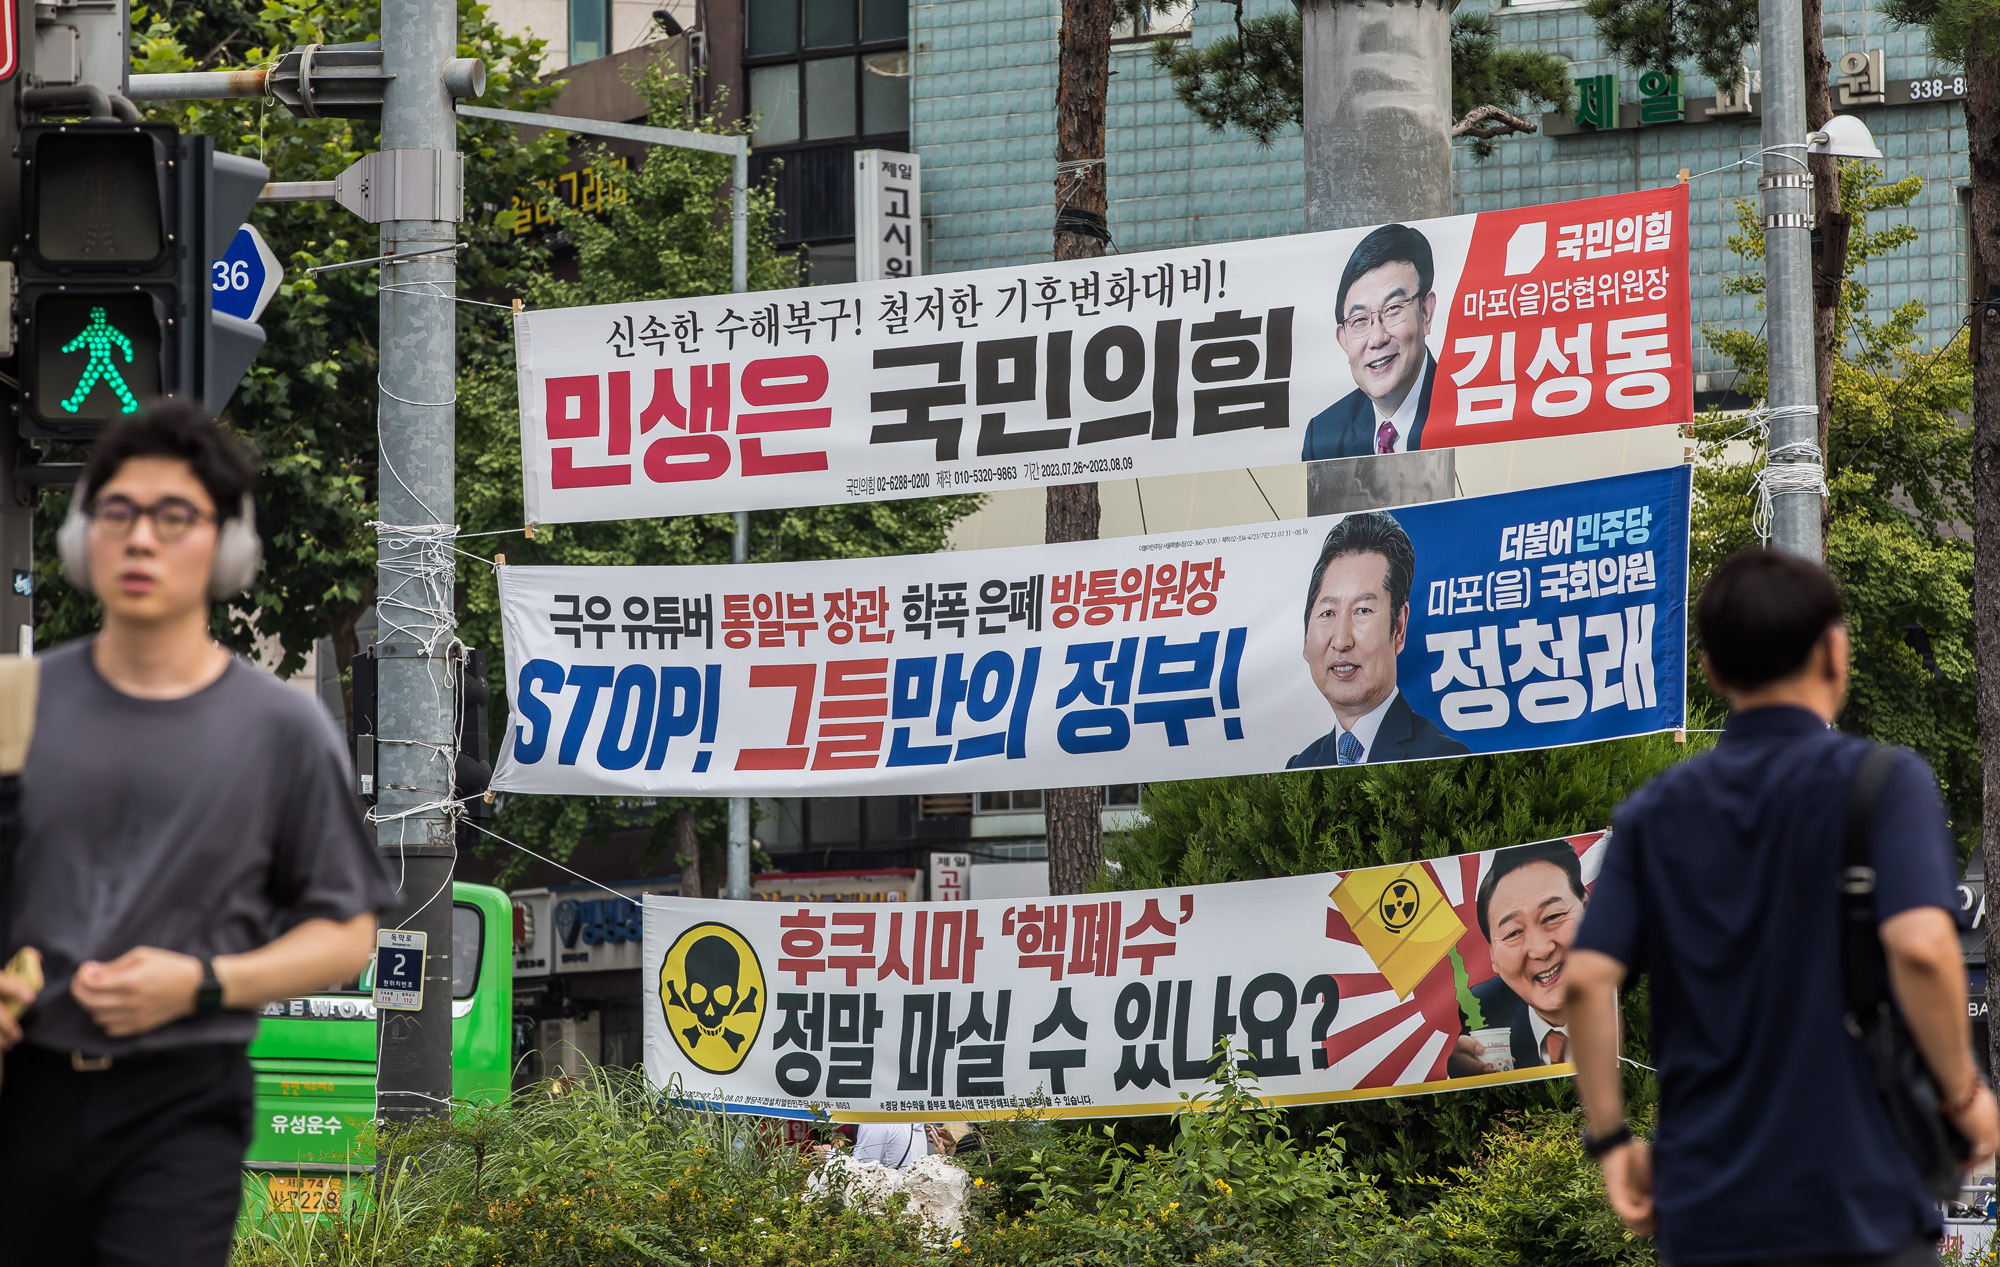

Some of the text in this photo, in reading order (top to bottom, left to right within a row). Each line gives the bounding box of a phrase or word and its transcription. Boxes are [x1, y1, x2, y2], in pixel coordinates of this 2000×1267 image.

[1910, 77, 1967, 100] 338-8
[881, 161, 912, 180] 제일
[1556, 210, 1672, 262] 국민의힘
[212, 260, 250, 291] 36
[1464, 266, 1670, 321] 마포(을)당협위원장
[606, 258, 1228, 358] 신속한 수해복구! 철저한 기후변화대비!
[545, 305, 1295, 490] 민생은 국민의힘
[1450, 313, 1672, 427] 김성동
[846, 456, 1133, 496] 국민의힘 02-6288-0200 제작 010-5320-9863 기간 2023.07.26~2023.08.09
[1500, 505, 1652, 562] 더불어민주당
[549, 556, 1226, 650] 극우 유튜버 통일부 장관, 학폭 은폐 방통위원장
[1428, 550, 1656, 616] 마포(을) 국회의원
[1425, 603, 1657, 731] 정청래
[513, 626, 1248, 773] STOP! 그들만의 정부!
[937, 856, 966, 867] 제일
[393, 953, 406, 976] 2
[778, 908, 984, 986] 후쿠시마
[773, 972, 1340, 1098] 정말 마실 수 있나요?
[271, 1115, 342, 1135] 유성운수
[900, 1100, 925, 1111] 현수막을
[1055, 1096, 1062, 1106] 수
[1063, 1095, 1094, 1106] 있습니다.
[308, 1179, 323, 1188] 74
